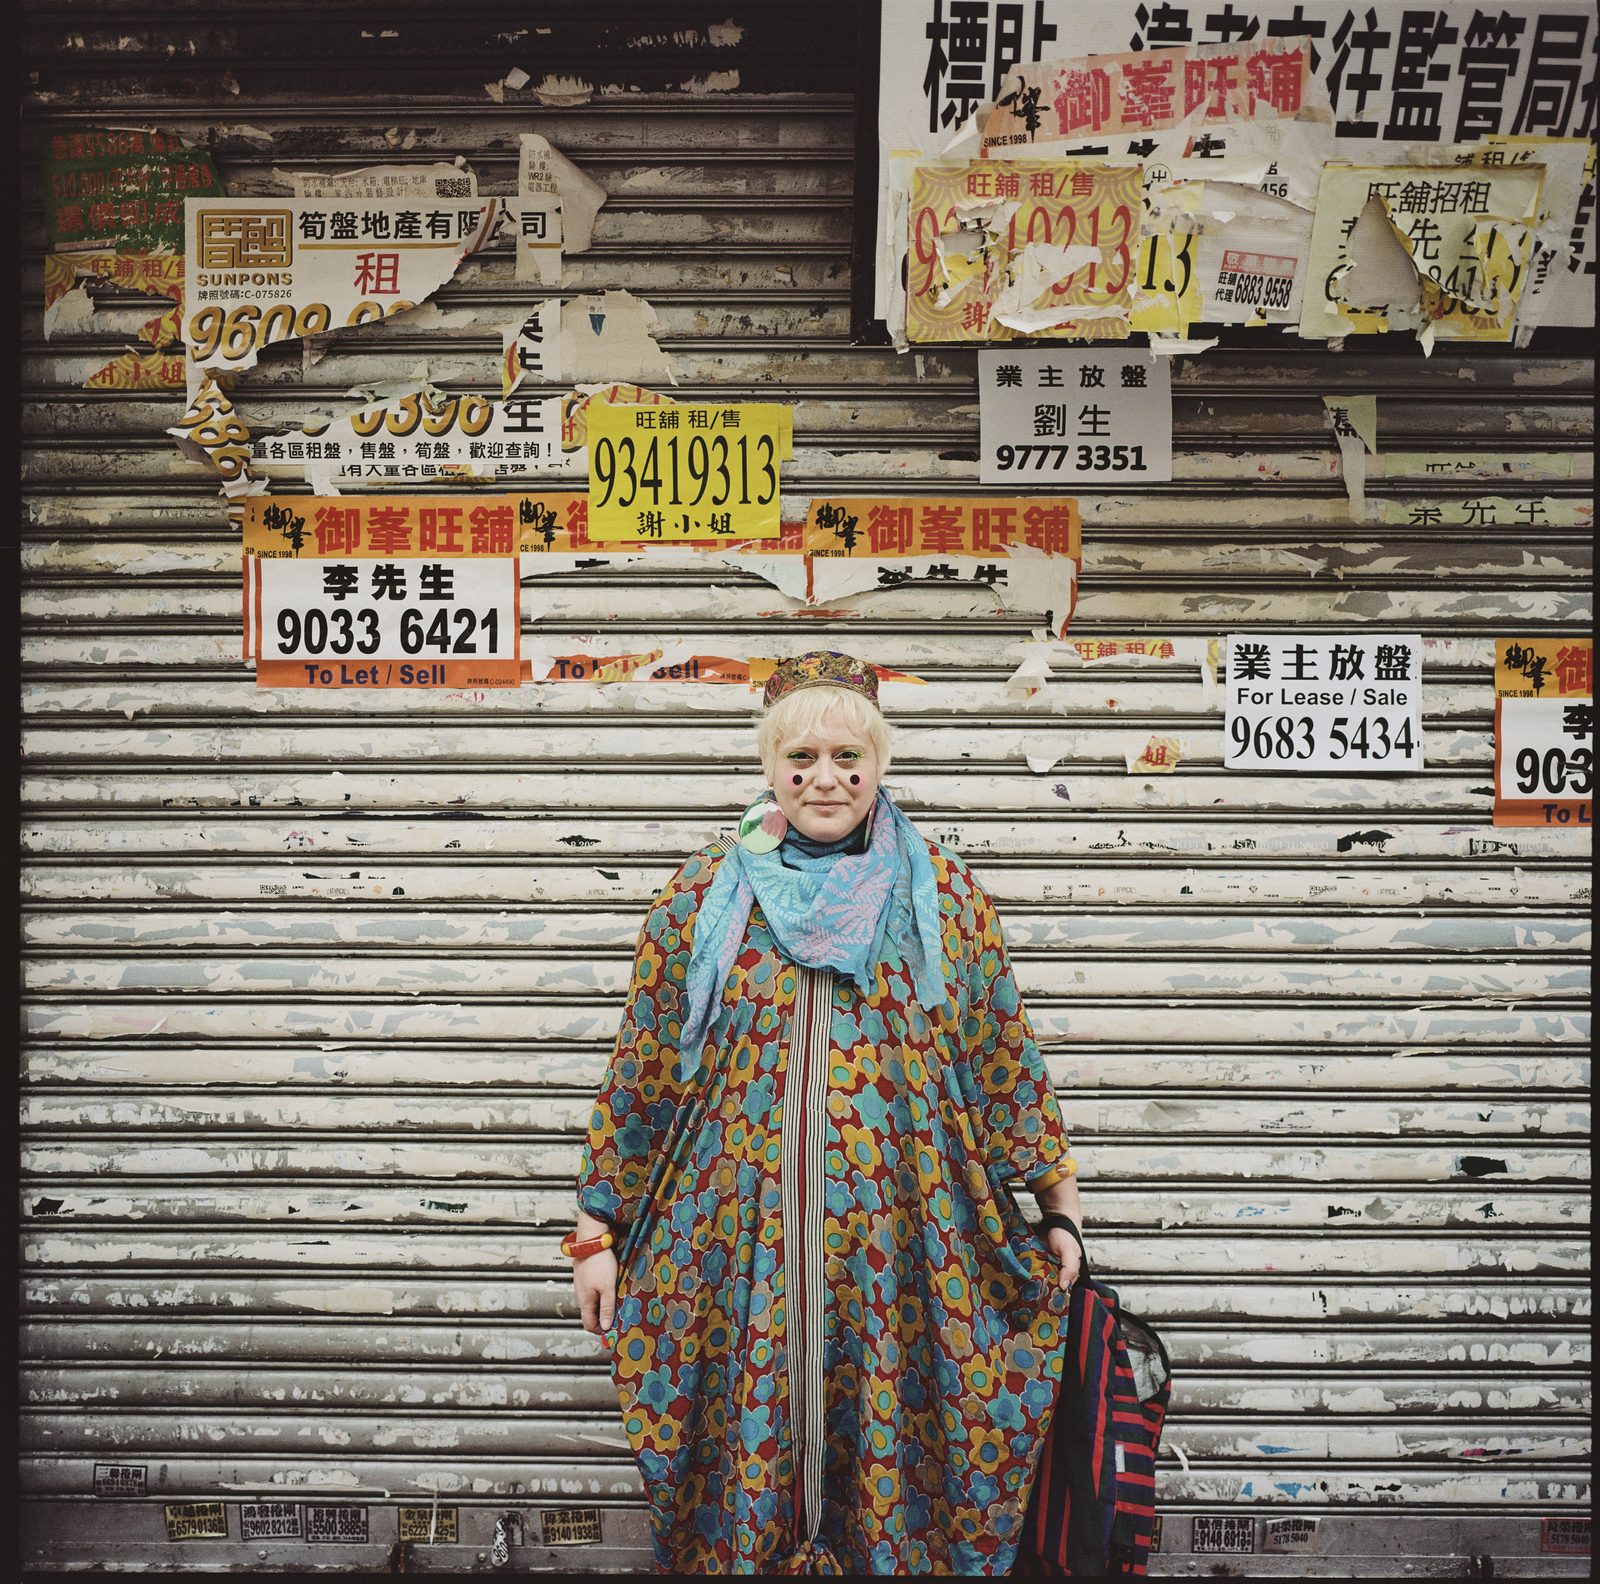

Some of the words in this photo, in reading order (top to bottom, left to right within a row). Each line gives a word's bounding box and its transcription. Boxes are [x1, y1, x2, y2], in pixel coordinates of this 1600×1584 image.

[983, 135, 1008, 147] SINCE
[1009, 134, 1027, 146] 1998
[196, 272, 293, 287] SUNPONS
[353, 252, 401, 297] 租
[996, 364, 1148, 388] 業主放盤
[1034, 403, 1111, 437] 劉生
[996, 445, 1069, 471] 9777
[1075, 445, 1148, 471] 3351
[594, 434, 776, 508] 93419313
[636, 510, 736, 538] 謝小姐
[257, 550, 278, 559] SINCE
[278, 550, 293, 559] 1998
[809, 550, 829, 558] SINCE
[831, 550, 846, 558] 1998
[323, 563, 455, 601] 李先生
[277, 608, 381, 655] 9033
[400, 608, 498, 655] 6421
[555, 660, 585, 680] To
[1233, 643, 1411, 681] 業主放盤
[305, 664, 333, 685] To
[340, 664, 379, 685] Let
[400, 664, 446, 685] Sell
[1237, 687, 1273, 705] For
[1281, 688, 1344, 706] Lease
[1363, 687, 1408, 706] Sale
[1498, 689, 1518, 698] SINCE
[1519, 689, 1534, 698] 1998
[1231, 715, 1315, 760] 9683
[1329, 716, 1414, 760] 5434
[1543, 804, 1570, 823] To
[176, 1519, 197, 1536] 6579
[250, 1519, 271, 1536] 9602
[271, 1518, 292, 1535] 8212
[313, 1520, 337, 1535] 5500
[338, 1520, 361, 1535] 3885
[573, 1524, 593, 1540] 1938
